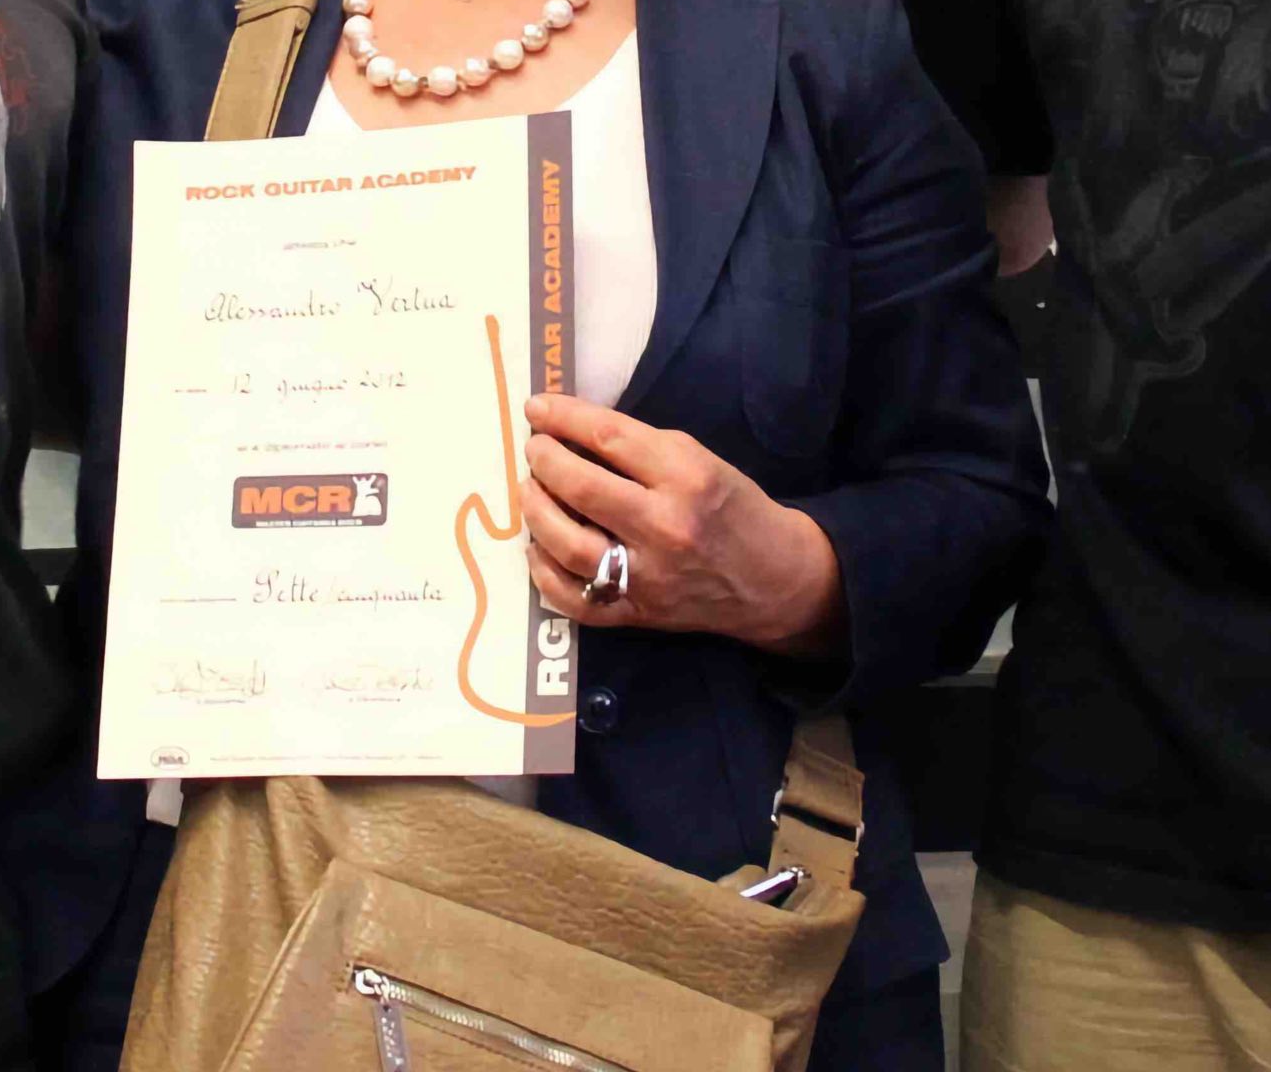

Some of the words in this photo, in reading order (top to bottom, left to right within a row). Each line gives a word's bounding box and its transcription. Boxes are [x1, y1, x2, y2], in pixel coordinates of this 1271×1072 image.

[186, 184, 255, 202] ROCK
[264, 176, 353, 197] GUITAR
[360, 166, 477, 190] ACADEMY
[542, 159, 563, 314] ACADEMY
[544, 322, 564, 394] ITAR
[240, 485, 352, 515] MCR
[536, 592, 571, 696] RG
